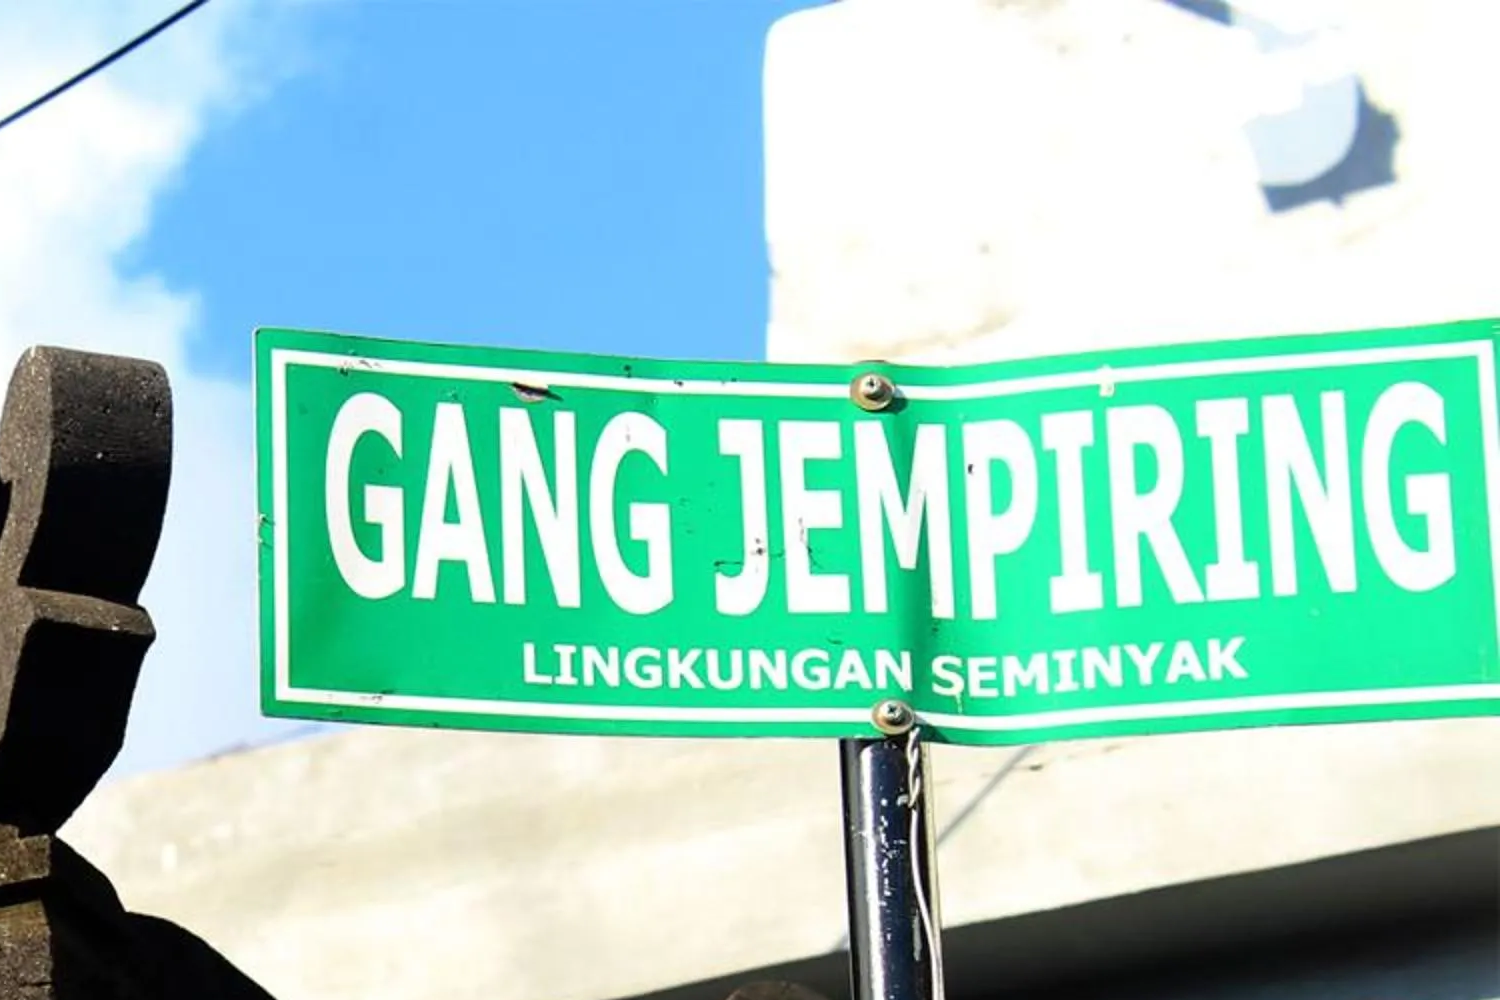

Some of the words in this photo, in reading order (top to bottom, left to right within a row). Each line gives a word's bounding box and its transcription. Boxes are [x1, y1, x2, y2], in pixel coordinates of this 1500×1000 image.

[325, 392, 675, 615] GANG
[713, 380, 1457, 620] JEMPIRING
[522, 642, 913, 691] LINGKUNGAN
[930, 635, 1249, 699] SEMINYAK
